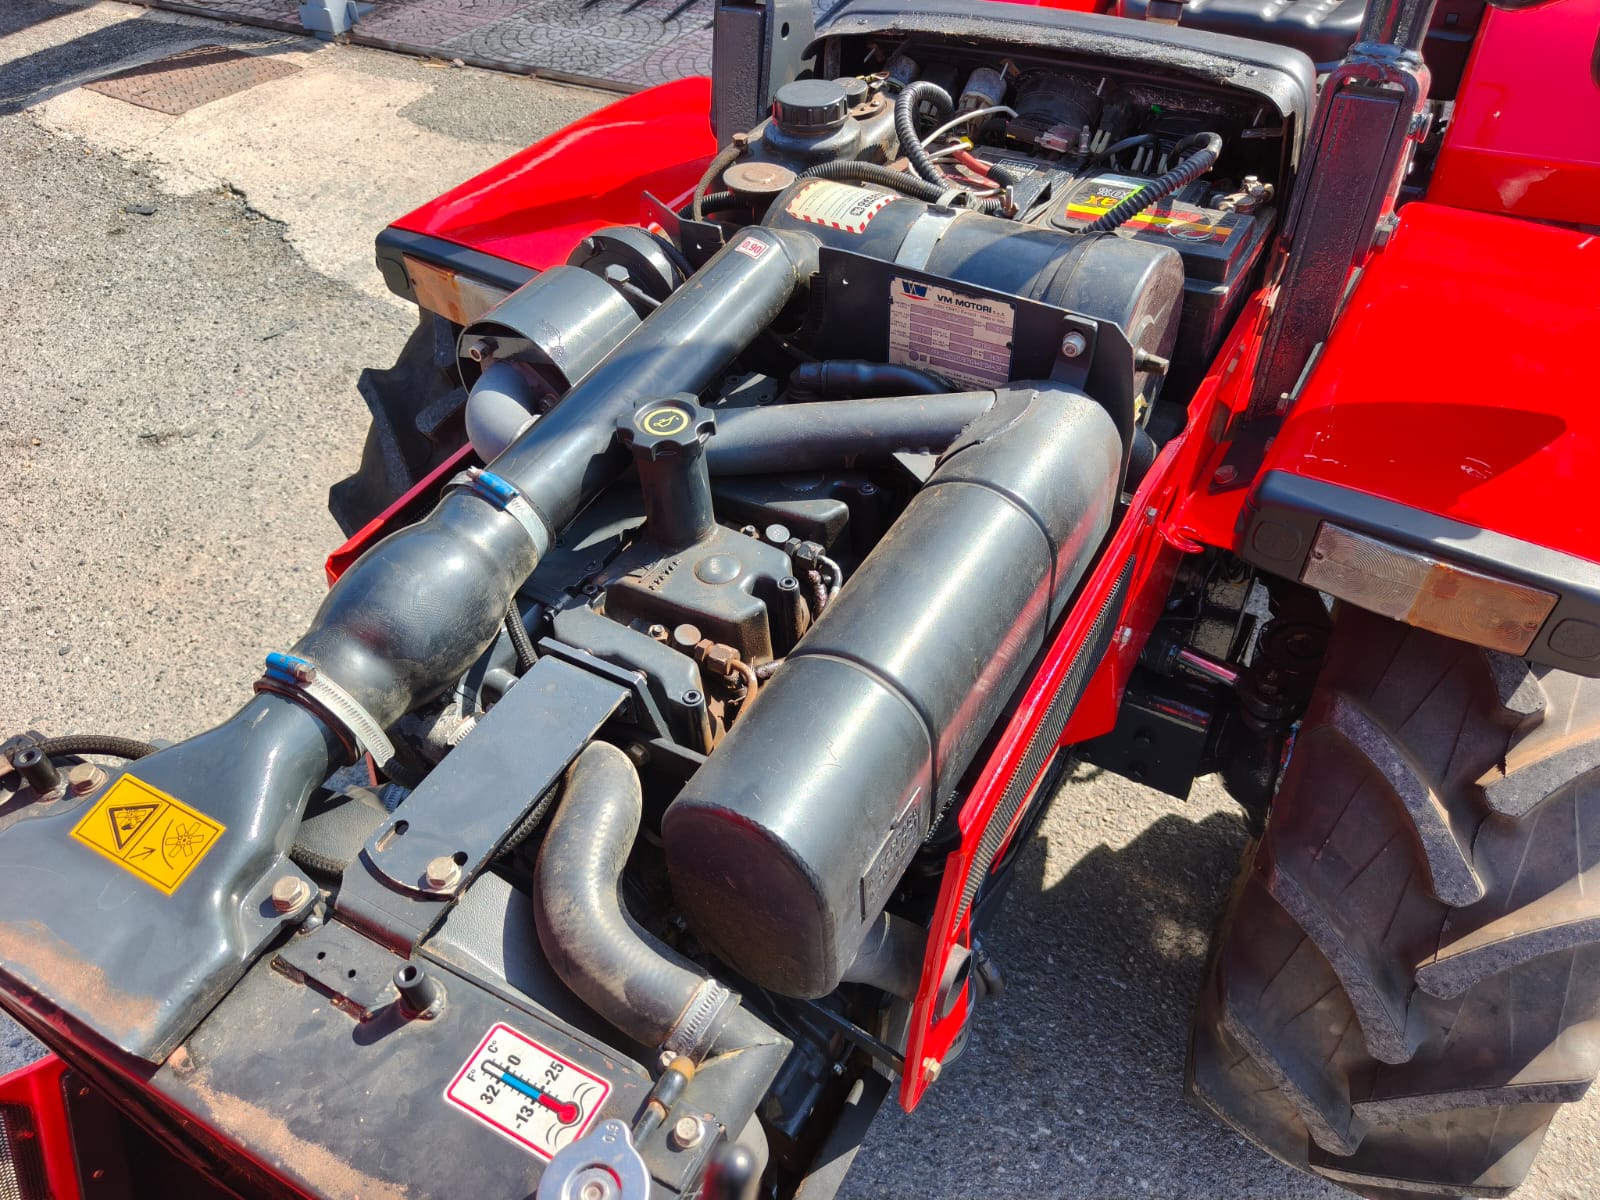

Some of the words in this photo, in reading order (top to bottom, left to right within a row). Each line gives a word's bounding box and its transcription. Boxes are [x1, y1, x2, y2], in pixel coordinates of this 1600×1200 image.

[742, 241, 762, 253] 0.90
[937, 294, 952, 304] VM
[955, 298, 992, 313] MOTORI
[507, 1054, 521, 1066] 0
[544, 1061, 564, 1085] -25
[480, 1084, 500, 1104] 32
[516, 1105, 534, 1129] -13
